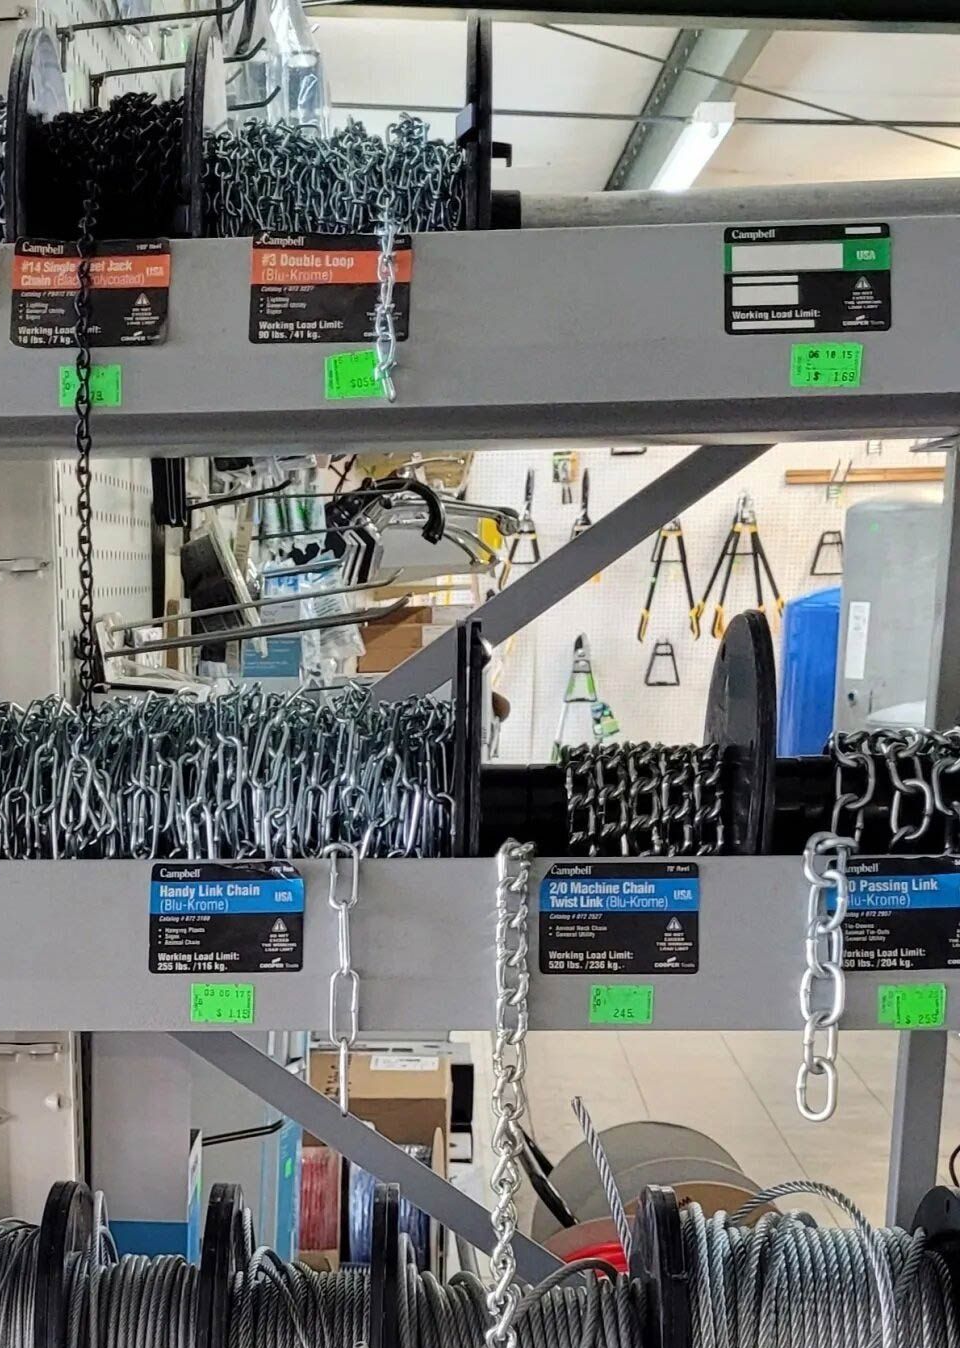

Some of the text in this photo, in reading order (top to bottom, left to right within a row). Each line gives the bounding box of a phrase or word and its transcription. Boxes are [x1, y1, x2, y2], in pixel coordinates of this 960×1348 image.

[732, 229, 775, 240] Campbell
[262, 234, 305, 247] Campbell
[856, 250, 876, 260] USA
[262, 254, 354, 269] #3 Double Loop
[262, 269, 332, 281] (Blu-Krome)
[160, 869, 200, 880] Campbell
[551, 866, 591, 876] Campbell
[160, 885, 260, 898] Handy Link Chain
[550, 882, 655, 895] 2/0 Machine Chain
[860, 880, 937, 893] Passing Link
[275, 892, 292, 902] USA
[674, 890, 692, 899] USA
[160, 899, 228, 912] (Blu-Krome)
[550, 896, 668, 909] Twist Link (Blu-Krome)
[549, 951, 633, 960] Working Load Limit:
[549, 961, 565, 969] 520
